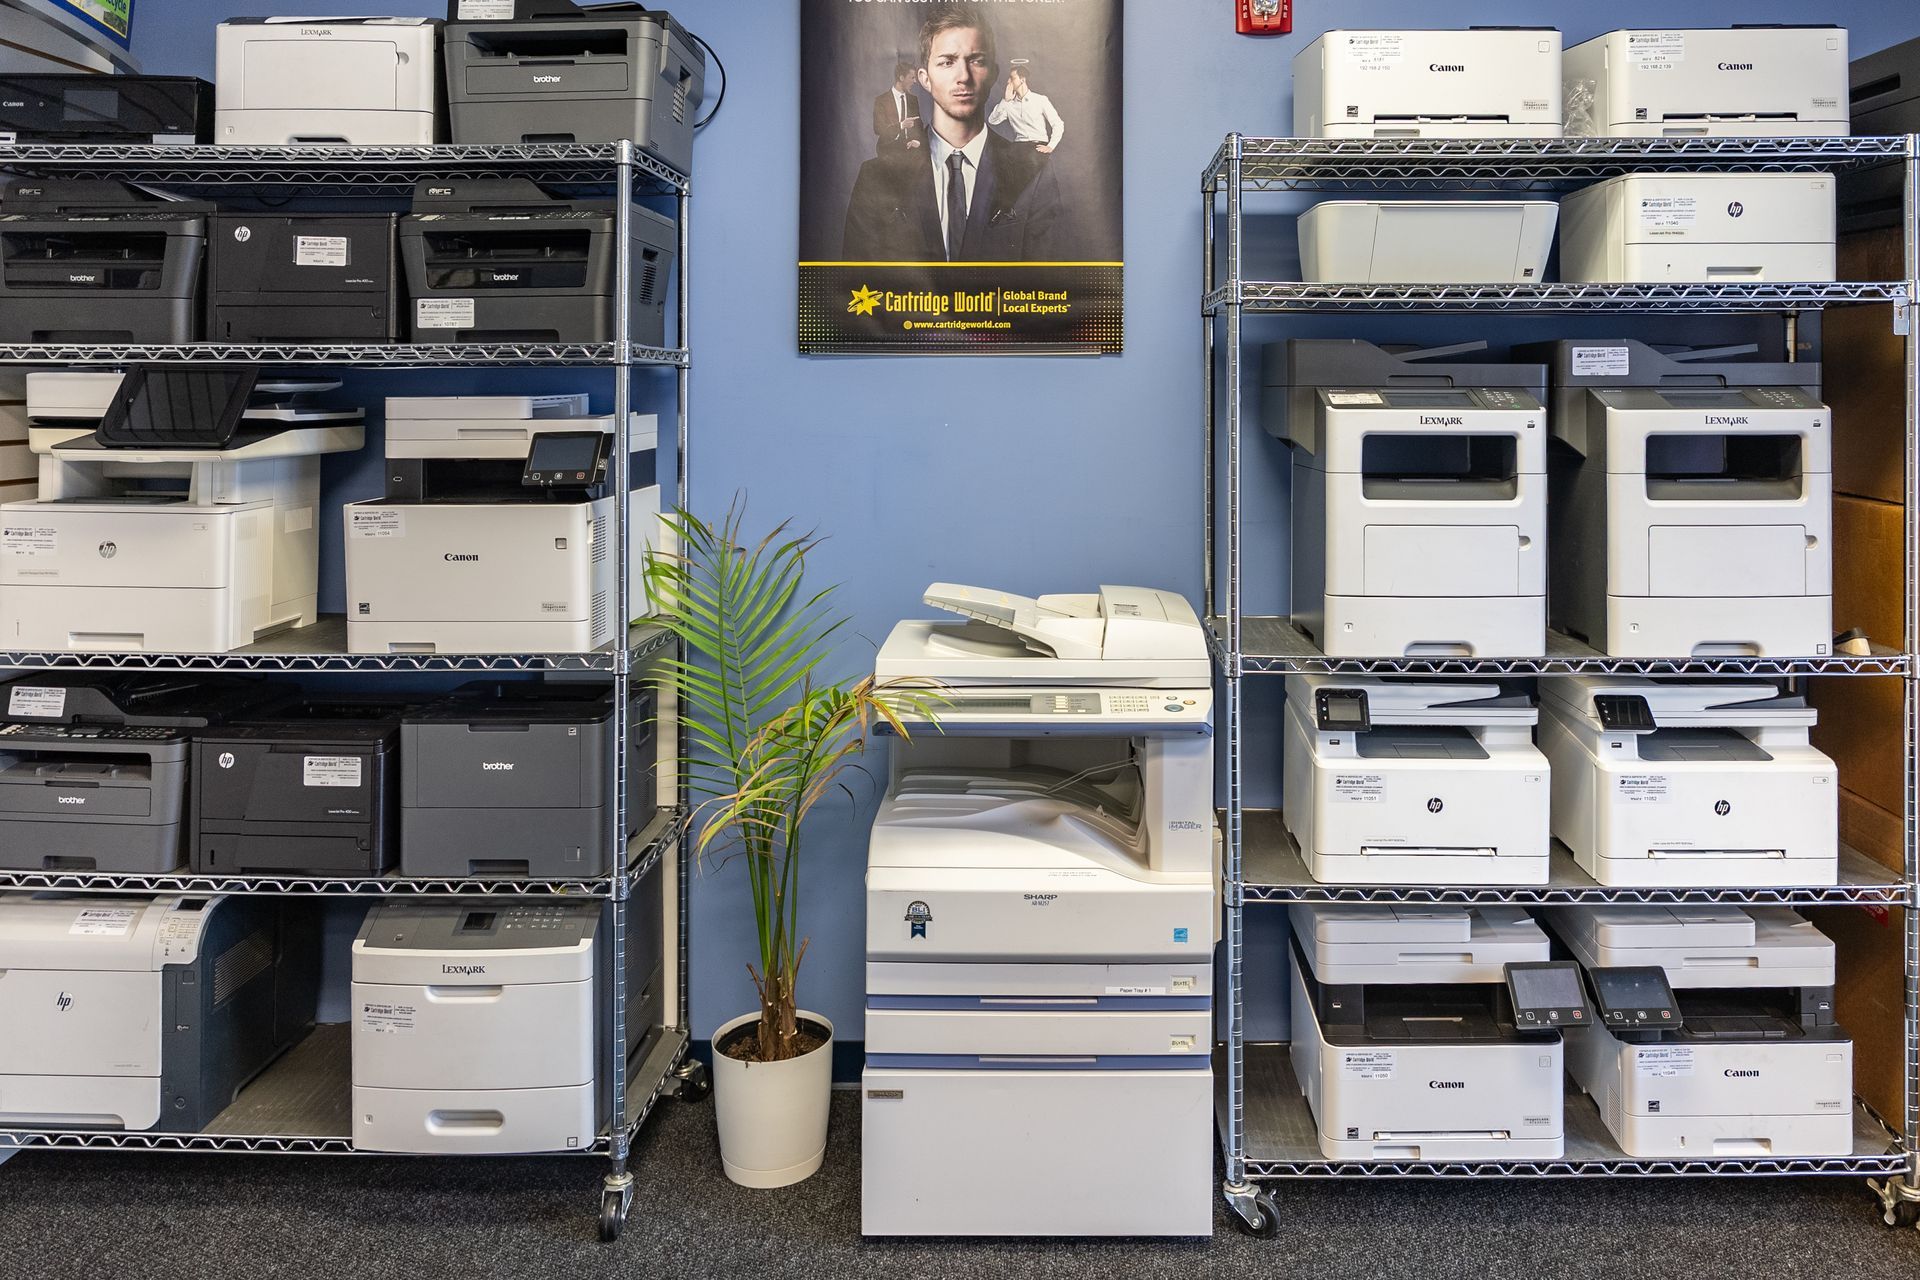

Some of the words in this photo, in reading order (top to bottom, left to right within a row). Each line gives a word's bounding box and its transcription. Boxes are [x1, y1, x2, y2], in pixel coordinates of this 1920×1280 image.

[301, 28, 332, 37] LEXMARK
[1429, 63, 1465, 72] Canon
[1718, 62, 1753, 71] Canon
[533, 75, 561, 83] brother
[1729, 202, 1743, 217] hp
[236, 226, 249, 242] hp
[70, 274, 95, 282] brother
[1003, 291, 1035, 300] Global
[1037, 291, 1067, 300] Brand
[885, 291, 949, 315] Cartridge
[1003, 303, 1029, 313] Local
[913, 320, 1011, 330] www.cartridgeworld.com
[1420, 415, 1463, 427] LEXMARK
[1705, 415, 1749, 427] LEXMARK
[100, 541, 117, 559] hp
[444, 553, 479, 561] Canon
[220, 752, 234, 769] hp
[483, 762, 514, 770] brother
[58, 796, 86, 804] brother
[1428, 797, 1443, 814] hp
[1715, 799, 1730, 816] hp
[442, 964, 485, 976] LEXMARK
[56, 992, 72, 1011] hp
[1724, 1069, 1760, 1078] Canon
[1429, 1080, 1465, 1089] Canon
